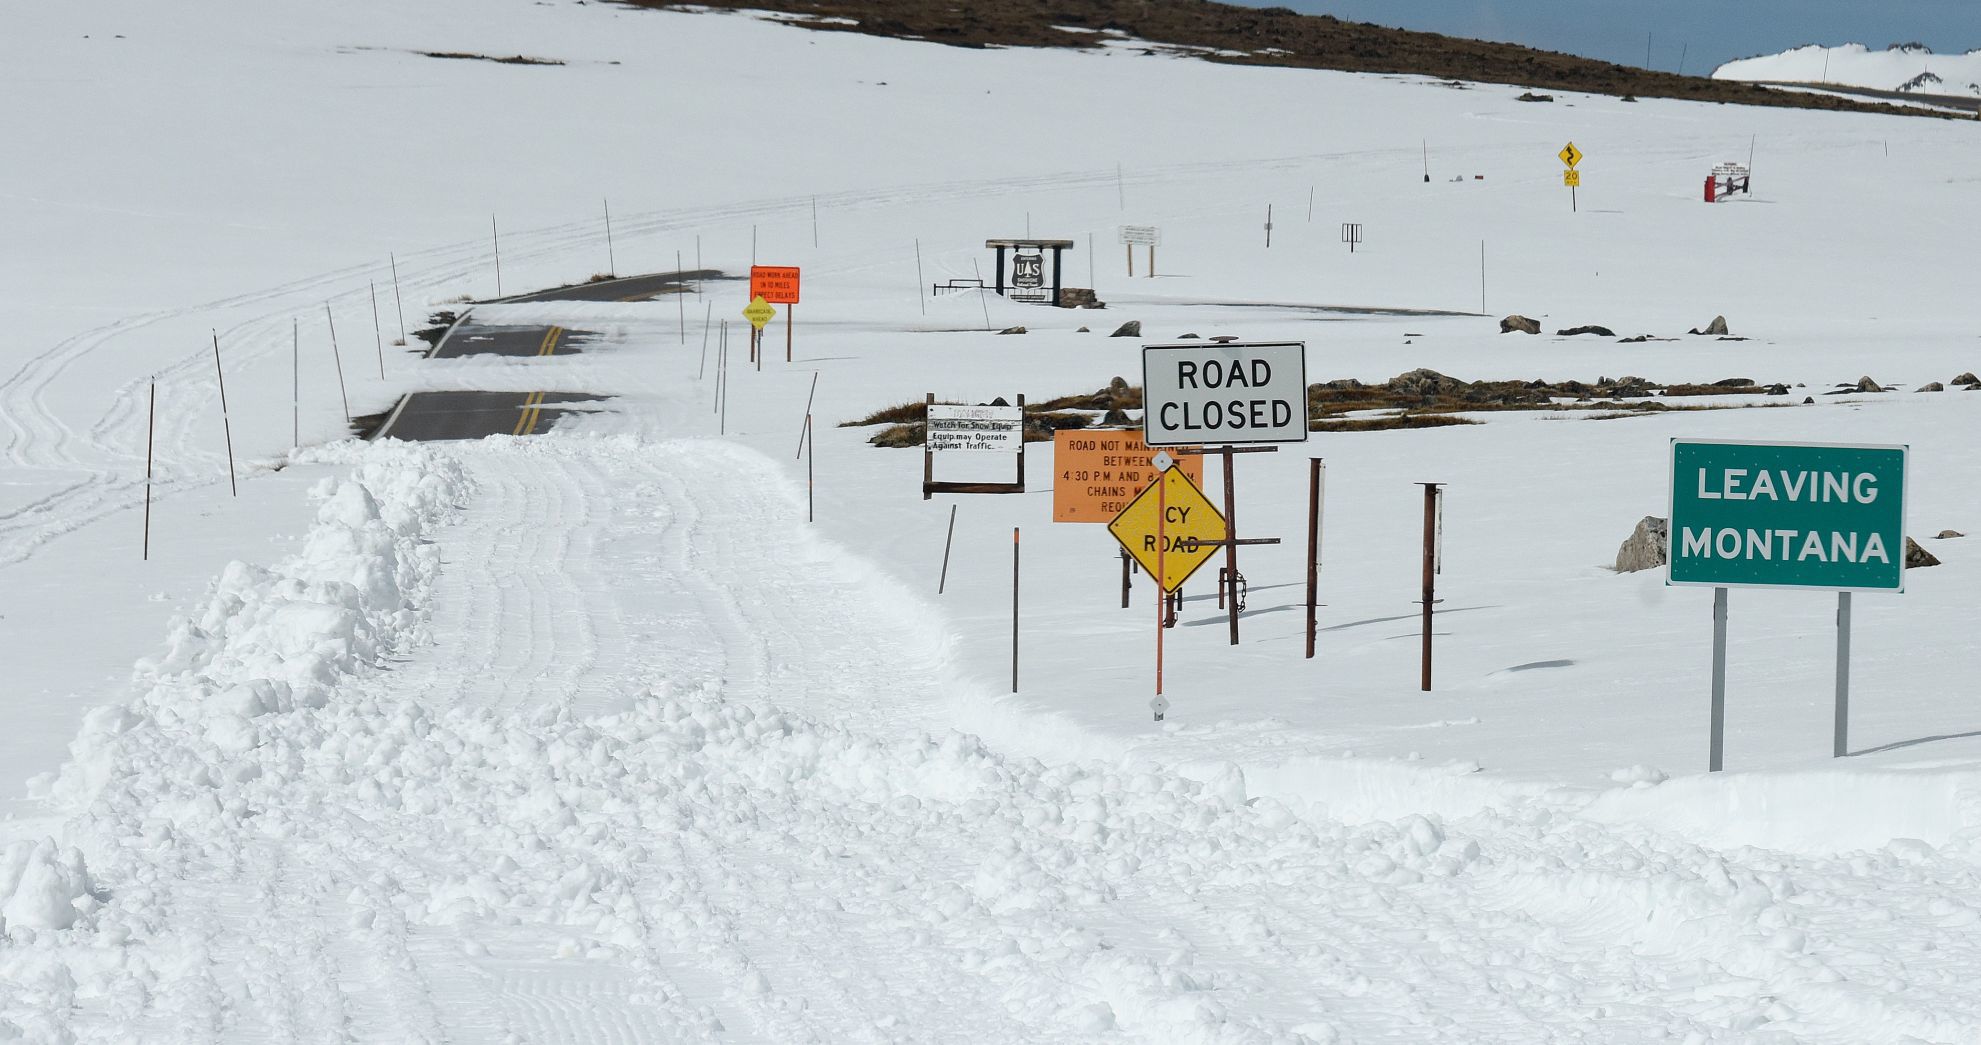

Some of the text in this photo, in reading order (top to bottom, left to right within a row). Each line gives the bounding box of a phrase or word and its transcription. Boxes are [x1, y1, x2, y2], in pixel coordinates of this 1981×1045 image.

[1565, 171, 1578, 180] 20
[1178, 359, 1272, 389] ROAD
[1160, 400, 1292, 431] CLOSED
[934, 421, 956, 429] Watch
[970, 421, 990, 430] Snow
[956, 434, 972, 442] may
[975, 432, 1008, 441] Operate
[932, 442, 962, 451] Against
[1069, 440, 1096, 451] ROAD
[1100, 440, 1120, 451] NOT
[1103, 455, 1153, 466] BETWEEN
[1063, 470, 1089, 481] 4:30
[1118, 471, 1140, 482] AND
[1698, 467, 1879, 504] LEAVING
[1087, 486, 1126, 497] CHAINS
[1165, 506, 1191, 524] CY
[1681, 526, 1890, 564] MONTANA
